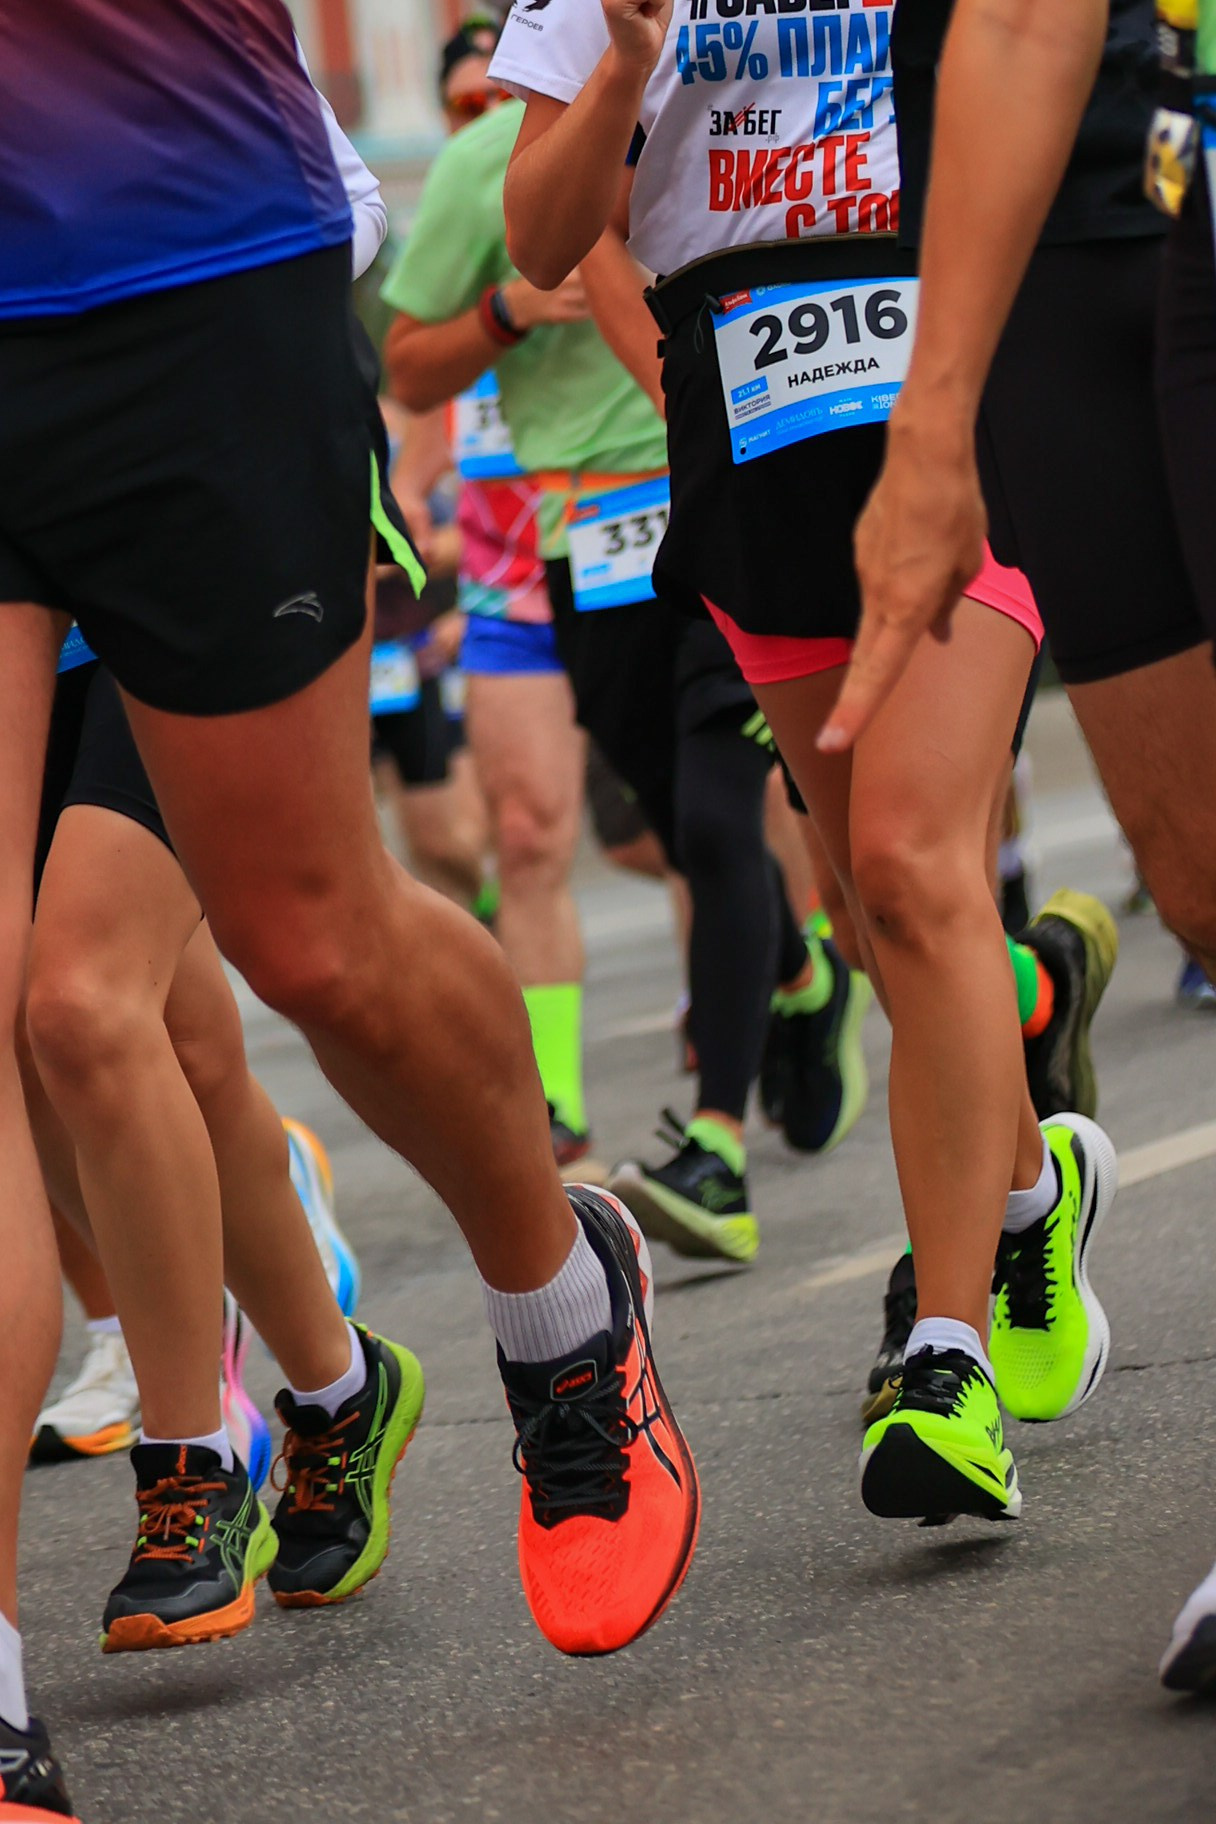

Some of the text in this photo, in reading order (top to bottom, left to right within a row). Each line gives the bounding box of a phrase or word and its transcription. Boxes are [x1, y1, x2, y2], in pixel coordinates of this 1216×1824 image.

[676, 20, 769, 85] 45%
[813, 76, 895, 141] БЕГ
[709, 131, 872, 212] ВМЕСТЕ
[749, 289, 908, 371] 2916
[788, 357, 880, 388] НАДЕЖДА
